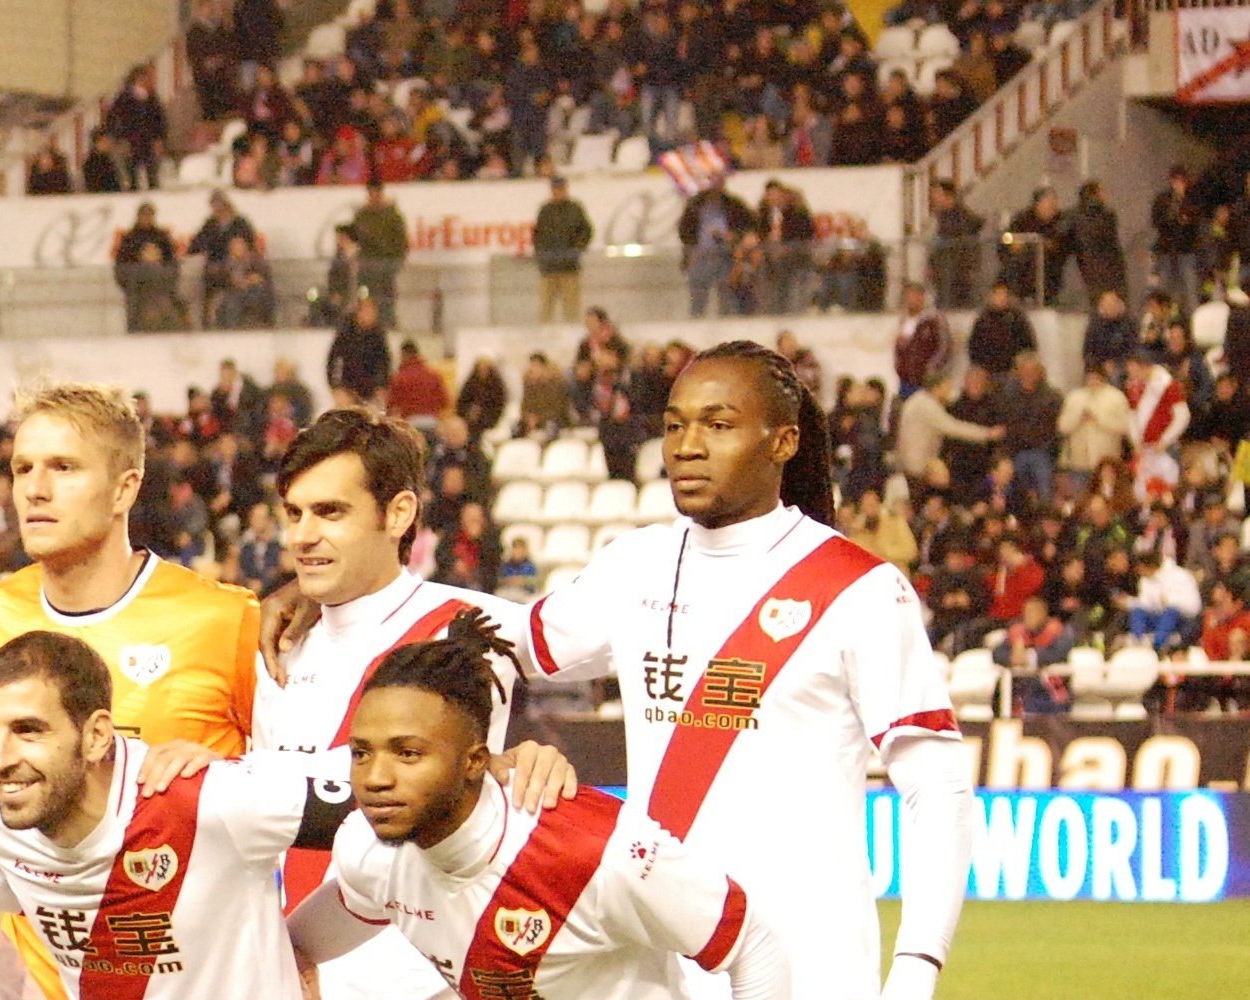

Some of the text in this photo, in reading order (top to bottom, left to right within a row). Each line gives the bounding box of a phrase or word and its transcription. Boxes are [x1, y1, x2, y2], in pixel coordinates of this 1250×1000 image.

[407, 214, 538, 258] irEurop
[286, 673, 316, 685] ELME
[643, 651, 766, 709] 钱宝
[645, 706, 759, 730] qbao.com
[972, 795, 1229, 902] WORLD
[384, 901, 435, 921] KELME
[35, 905, 180, 957] 钱宝
[53, 952, 183, 976] qbao.com
